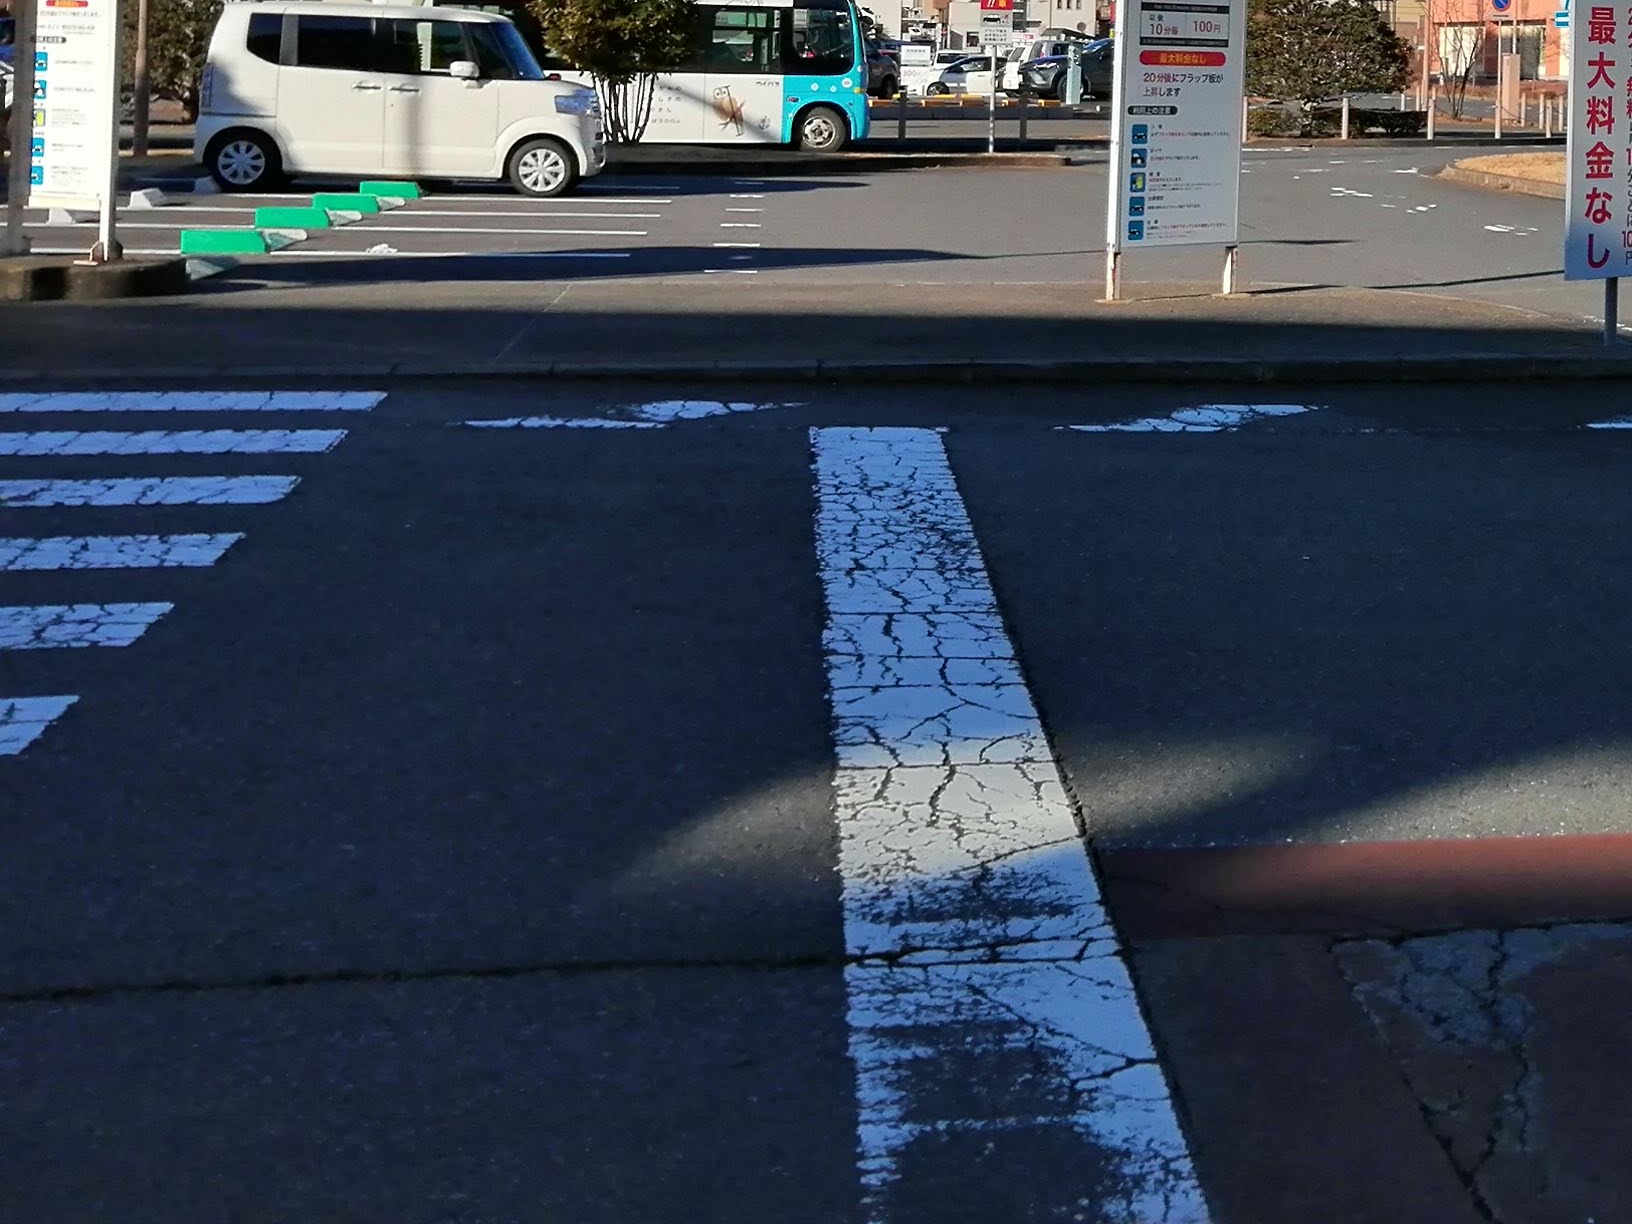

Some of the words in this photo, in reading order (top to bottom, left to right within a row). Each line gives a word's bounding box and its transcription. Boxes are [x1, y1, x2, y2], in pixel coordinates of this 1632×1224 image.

[1193, 20, 1221, 33] 100円
[1159, 53, 1207, 64] 最大料金なし
[1143, 72, 1224, 83] 20分後にフラップ板が
[1585, 6, 1617, 269] 最大料金なし
